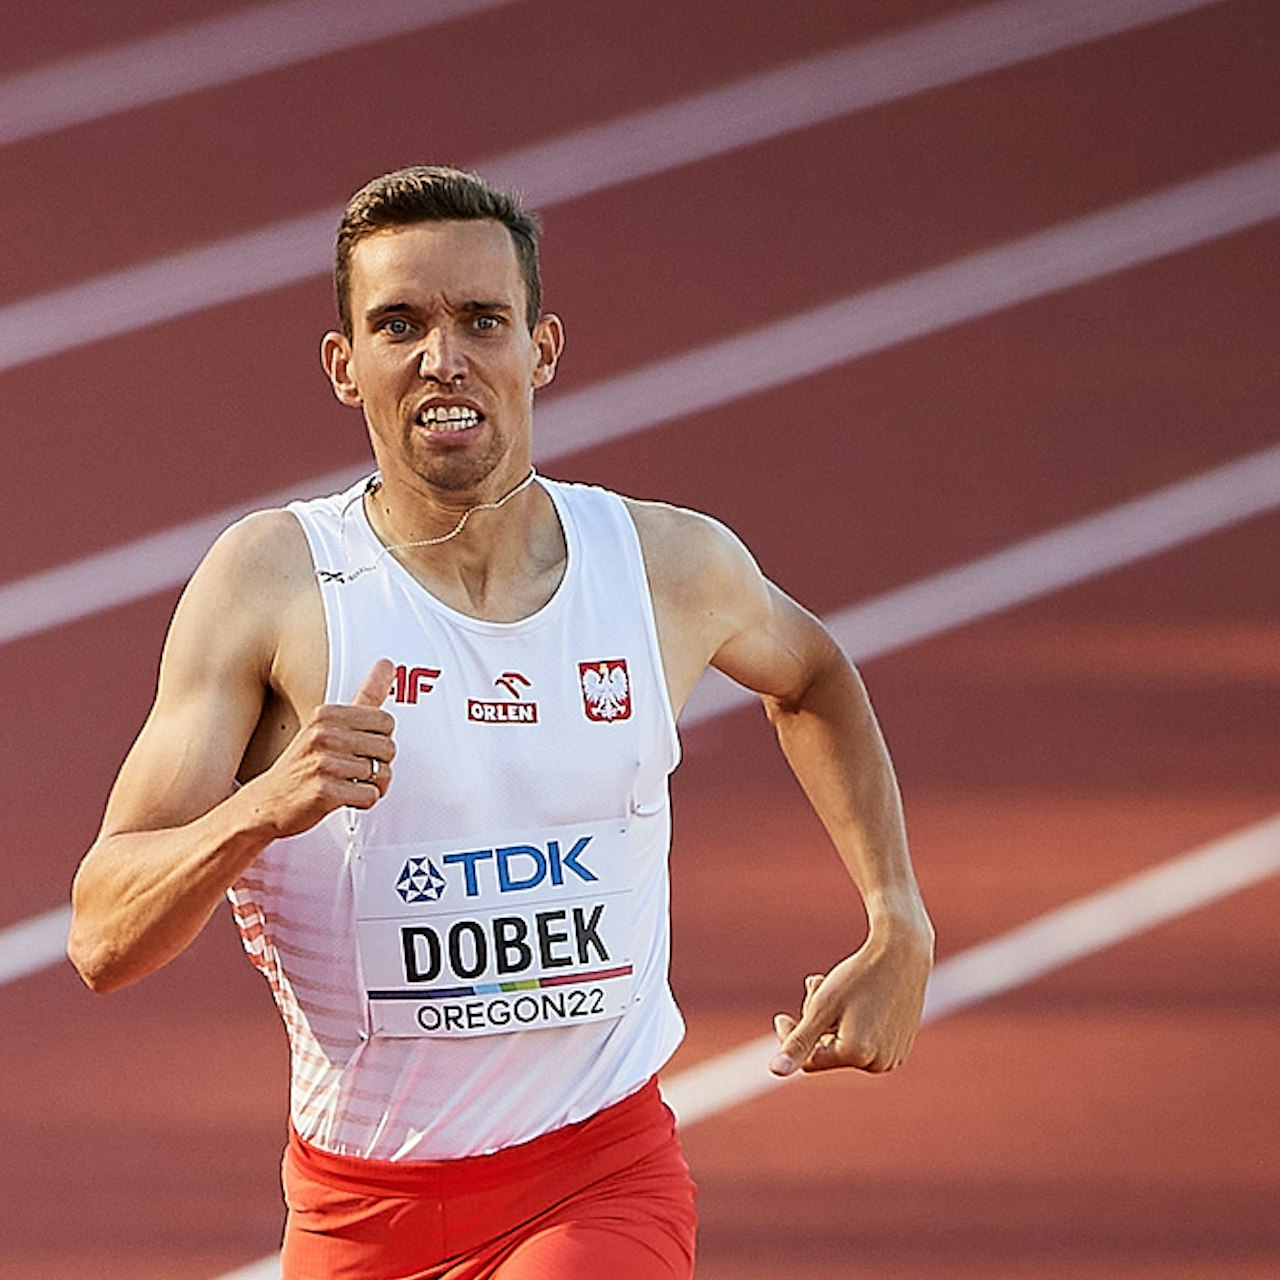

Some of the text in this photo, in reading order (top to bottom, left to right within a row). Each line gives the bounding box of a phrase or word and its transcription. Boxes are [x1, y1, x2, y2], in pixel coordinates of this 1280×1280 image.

[470, 702, 535, 722] ORLEN
[443, 836, 599, 897] TDK
[401, 904, 610, 984] DOBEK
[417, 988, 605, 1031] OREGON22
